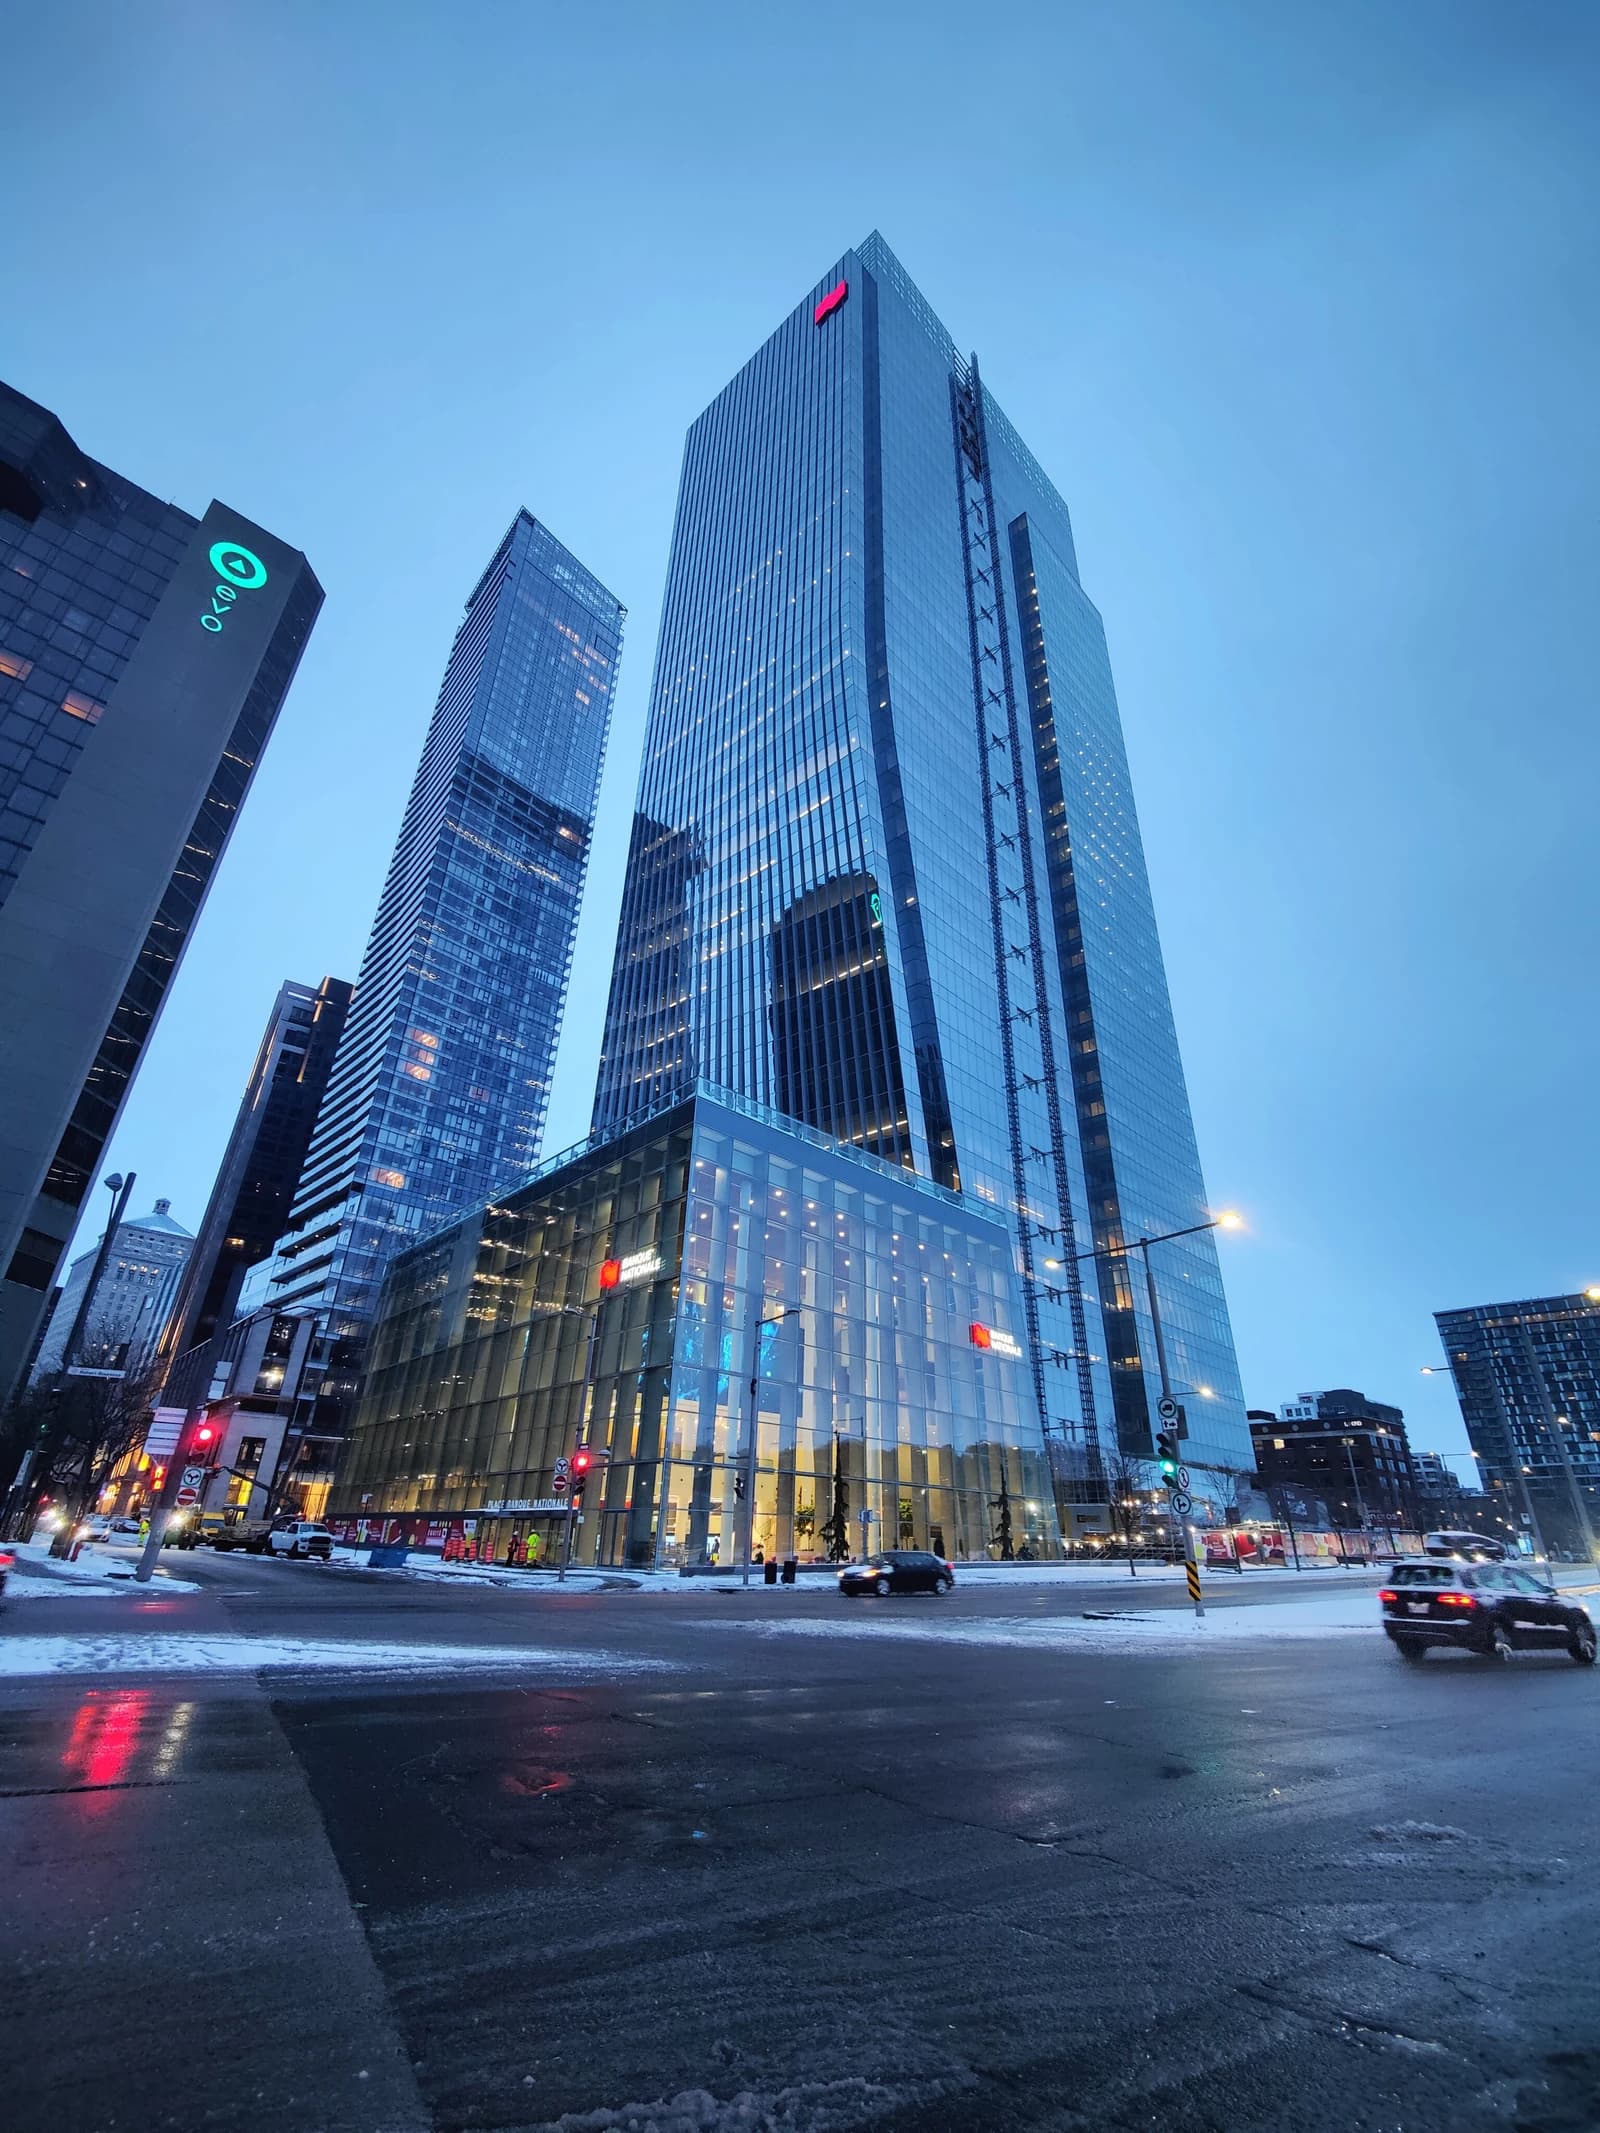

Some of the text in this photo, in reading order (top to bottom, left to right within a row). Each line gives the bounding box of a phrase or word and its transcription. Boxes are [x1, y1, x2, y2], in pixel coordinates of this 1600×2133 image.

[487, 1498, 568, 1509] PLACE BANQUE NATIONALE
